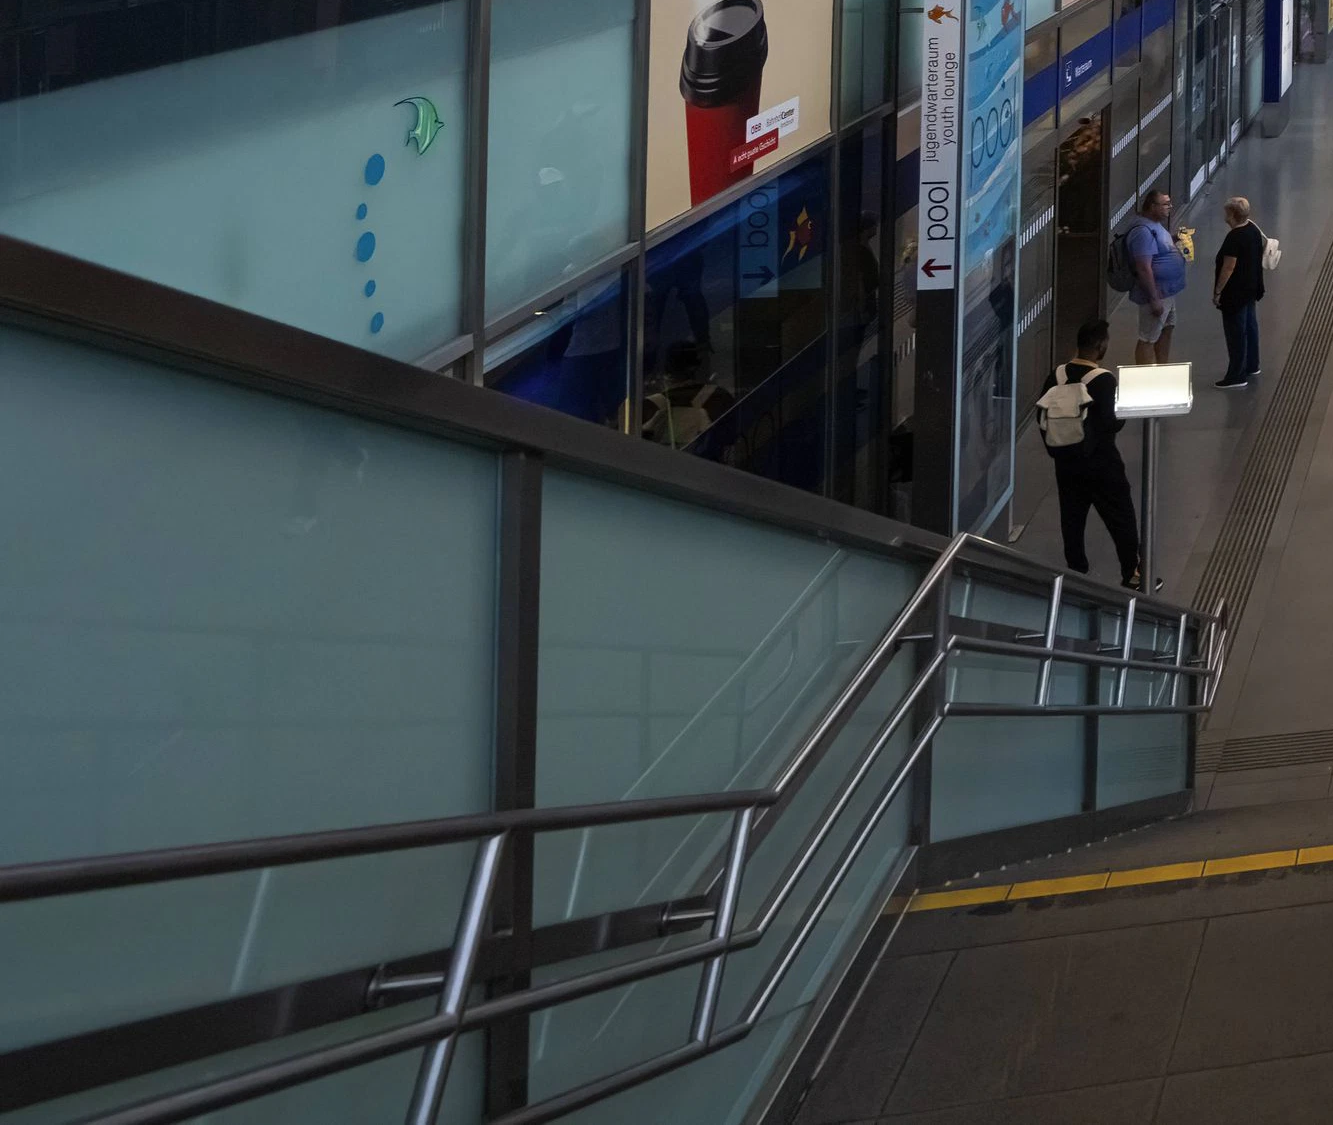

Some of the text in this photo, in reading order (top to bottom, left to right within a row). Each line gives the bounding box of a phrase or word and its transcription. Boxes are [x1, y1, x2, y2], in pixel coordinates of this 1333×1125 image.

[922, 37, 939, 163] jugendwarteraum
[943, 52, 959, 146] youth lounge
[970, 77, 1017, 187] pool
[921, 181, 954, 241] pool
